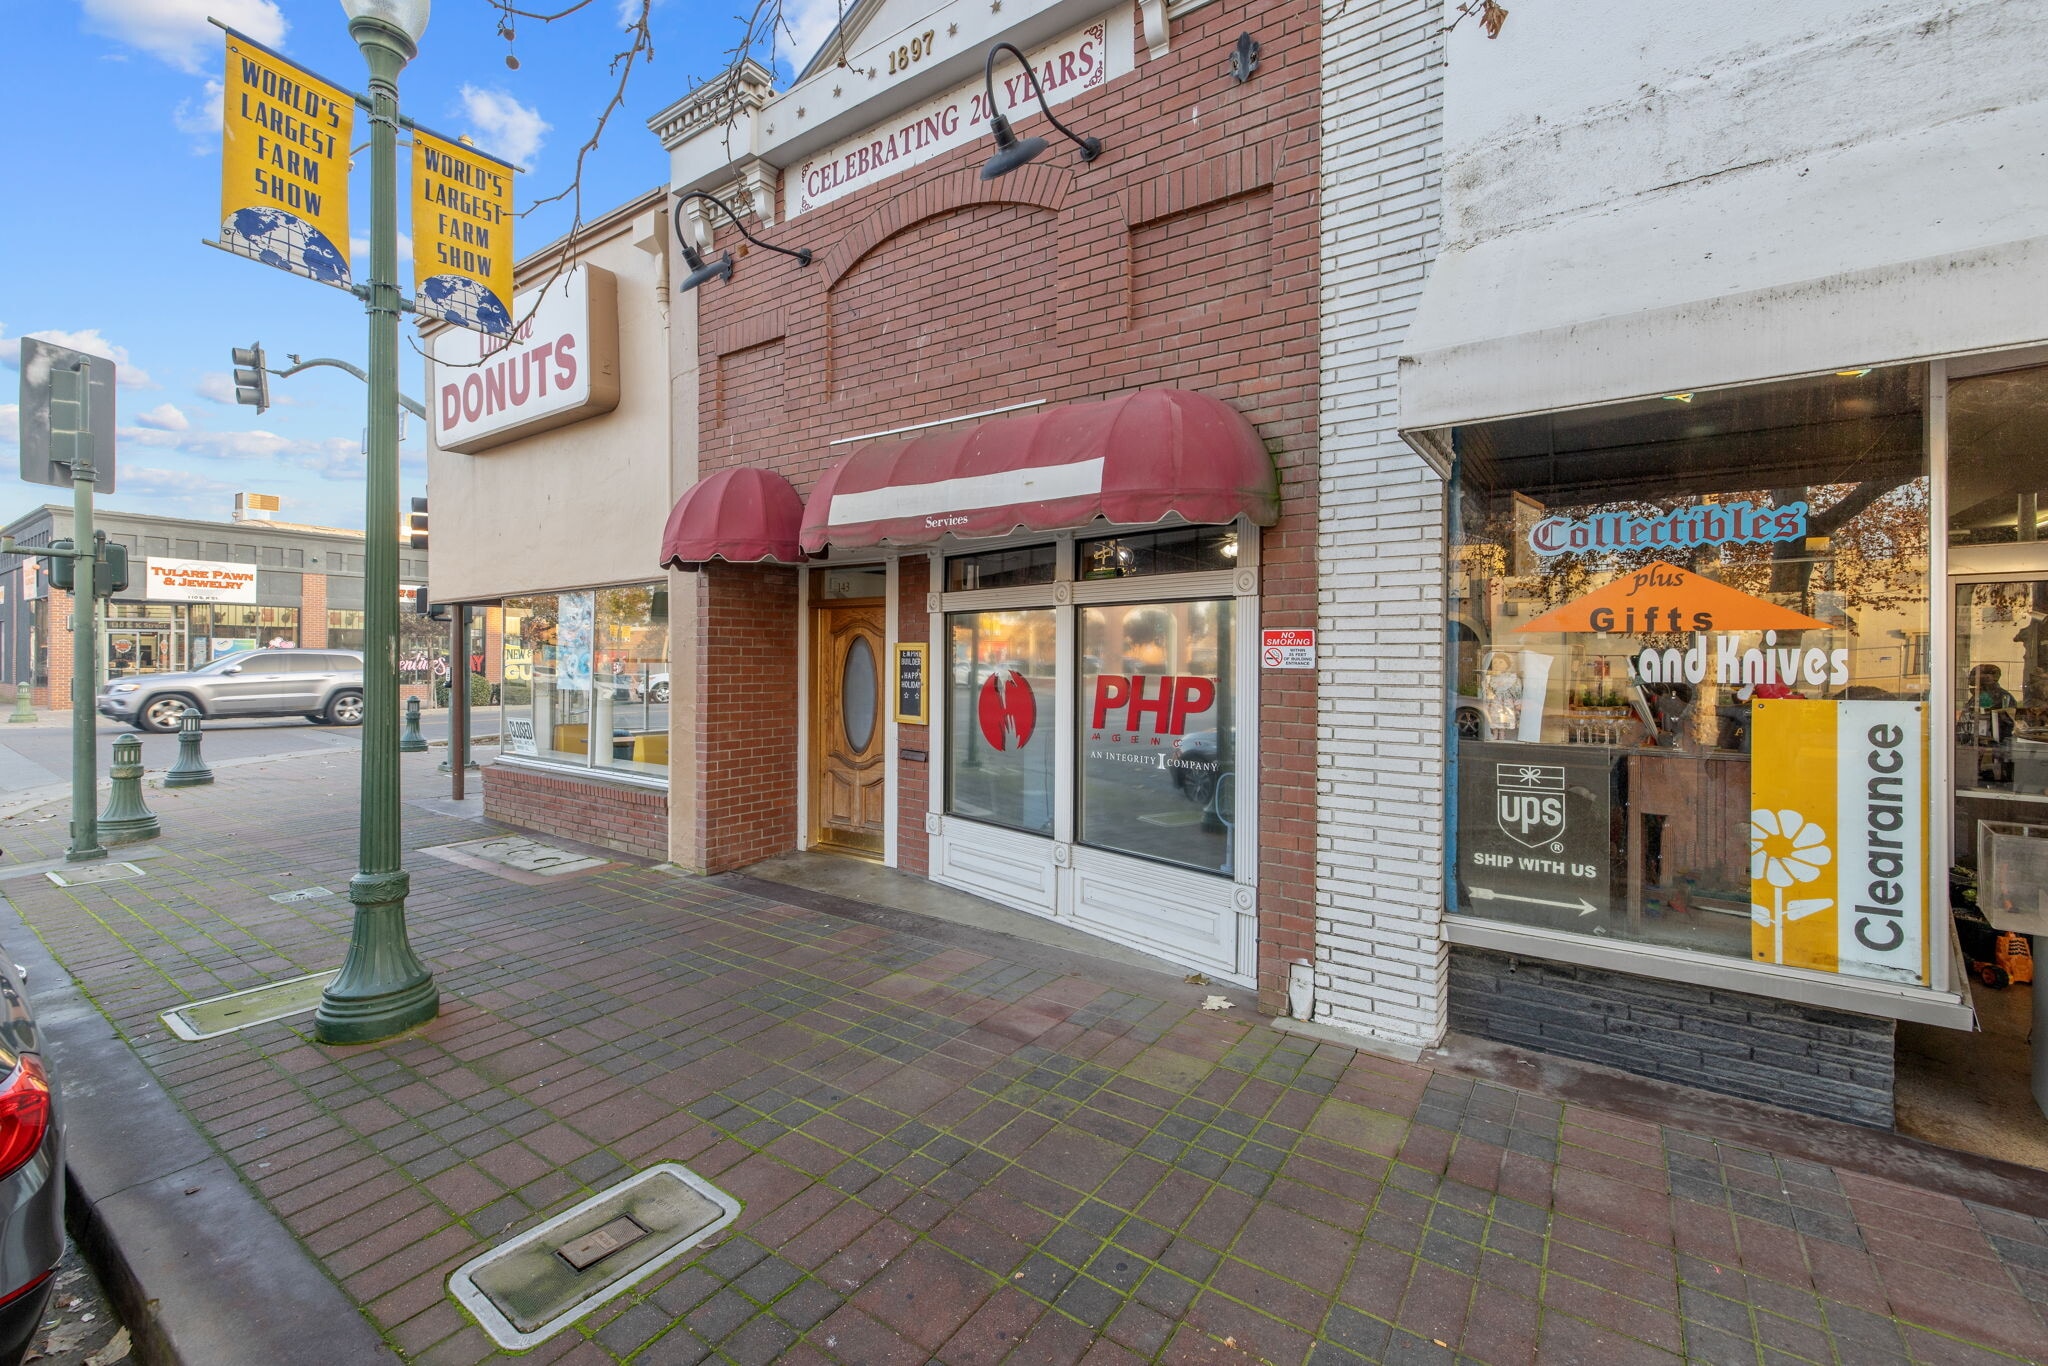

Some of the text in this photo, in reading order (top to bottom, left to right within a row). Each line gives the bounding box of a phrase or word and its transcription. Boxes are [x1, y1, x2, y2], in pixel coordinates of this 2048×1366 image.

[888, 29, 934, 75] 1897
[241, 57, 340, 129] WORLD'S
[241, 92, 336, 160] LARGEST
[807, 104, 960, 198] CELEBRATING
[1004, 41, 1094, 109] YEARS
[257, 135, 319, 185] FARM
[423, 146, 503, 198] WORLD'S
[255, 168, 322, 217] SHOW
[424, 178, 502, 225] LARGEST
[438, 213, 489, 250] FARM
[437, 242, 492, 278] SHOW
[441, 333, 578, 432] DONUTS
[925, 513, 968, 528] Services
[1532, 505, 1804, 551] Collectibles
[151, 566, 254, 581] TULARE PAWN
[163, 577, 244, 590] & JEWELRY
[838, 582, 850, 592] 143
[1626, 562, 1685, 597] plus
[1281, 631, 1296, 639] NO
[1590, 605, 1714, 632] Gifts
[1266, 638, 1310, 646] SMOKING
[1638, 629, 1849, 686] and Knives
[1092, 675, 1216, 736] PHP
[509, 720, 533, 740] CLOSED
[1090, 751, 1102, 759] AN
[1106, 752, 1156, 765] INTEGRITY
[1167, 758, 1219, 772] COMPANY
[1853, 723, 1905, 952] Clearance
[1473, 852, 1597, 878] SHIP WITH US
